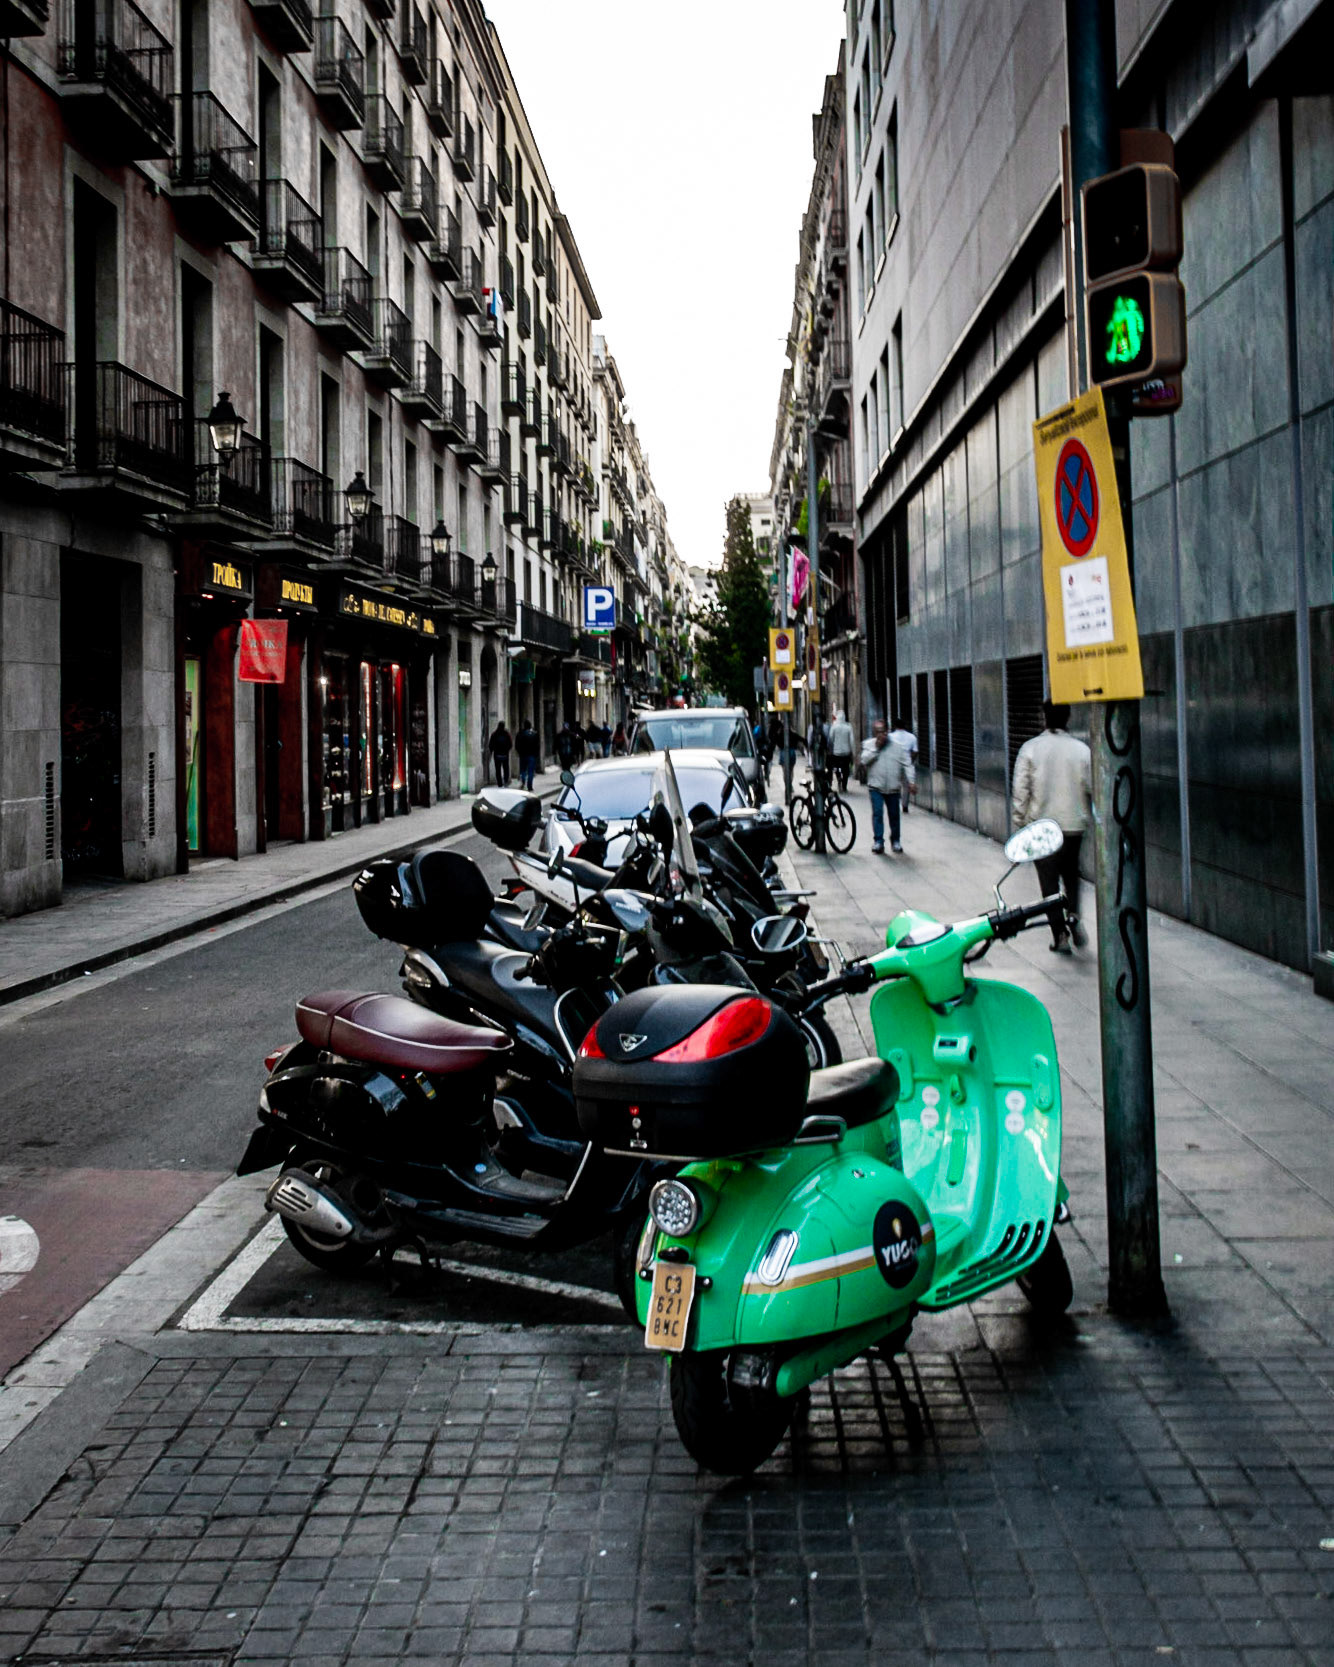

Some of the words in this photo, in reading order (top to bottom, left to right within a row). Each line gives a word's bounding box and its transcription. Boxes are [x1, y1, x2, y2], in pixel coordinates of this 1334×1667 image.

[212, 562, 242, 590] ТРОЙКА
[587, 588, 613, 621] P
[881, 1236, 918, 1267] YUGO
[665, 1275, 682, 1294] C3
[656, 1295, 682, 1316] 621
